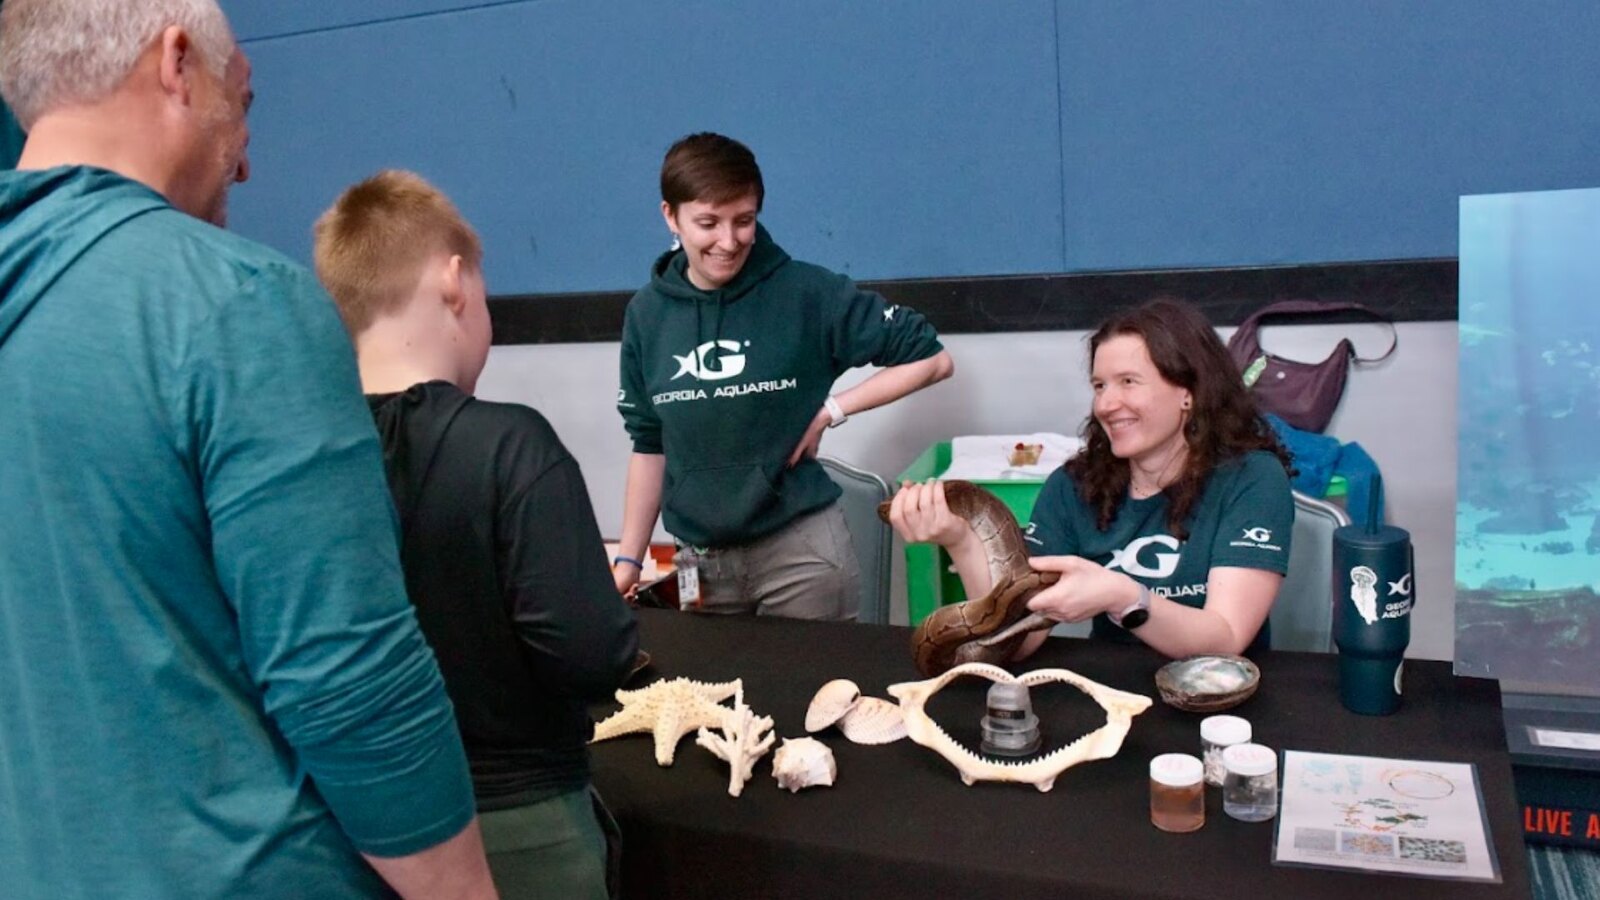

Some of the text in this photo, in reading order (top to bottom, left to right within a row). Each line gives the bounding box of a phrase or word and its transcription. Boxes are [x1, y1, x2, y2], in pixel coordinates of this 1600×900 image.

[714, 378, 797, 398] AQUARIUM
[1149, 583, 1208, 598] QUAR
[1524, 806, 1572, 837] LIVE
